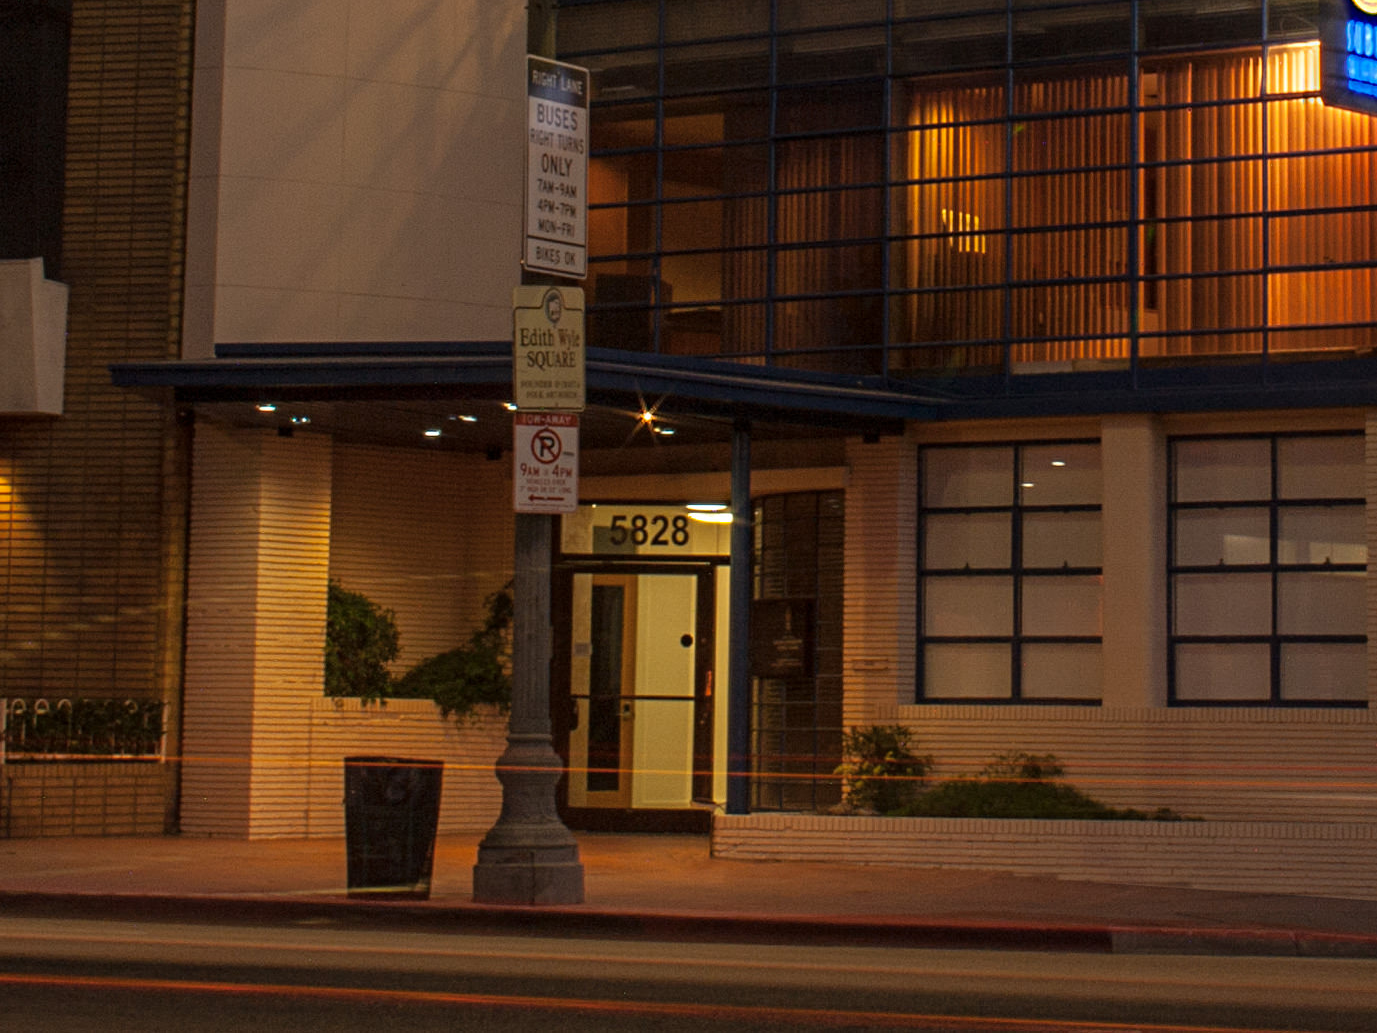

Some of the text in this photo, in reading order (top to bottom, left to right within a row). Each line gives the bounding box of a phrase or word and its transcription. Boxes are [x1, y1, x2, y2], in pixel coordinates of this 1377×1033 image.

[532, 69, 583, 95] RIGHT LANE
[537, 103, 578, 131] BUSES
[530, 128, 584, 155] RIGHT TURNS
[541, 154, 573, 177] ONLY
[537, 178, 577, 199] 7AM-9AM
[537, 198, 576, 218] 4PM-7PM
[538, 219, 575, 238] MON-FRI
[536, 246, 576, 265] BIKES OK
[520, 328, 580, 351] Edith Wyle
[527, 350, 576, 372] SQUARE
[520, 463, 540, 477] 9AM
[610, 514, 689, 546] 5828
